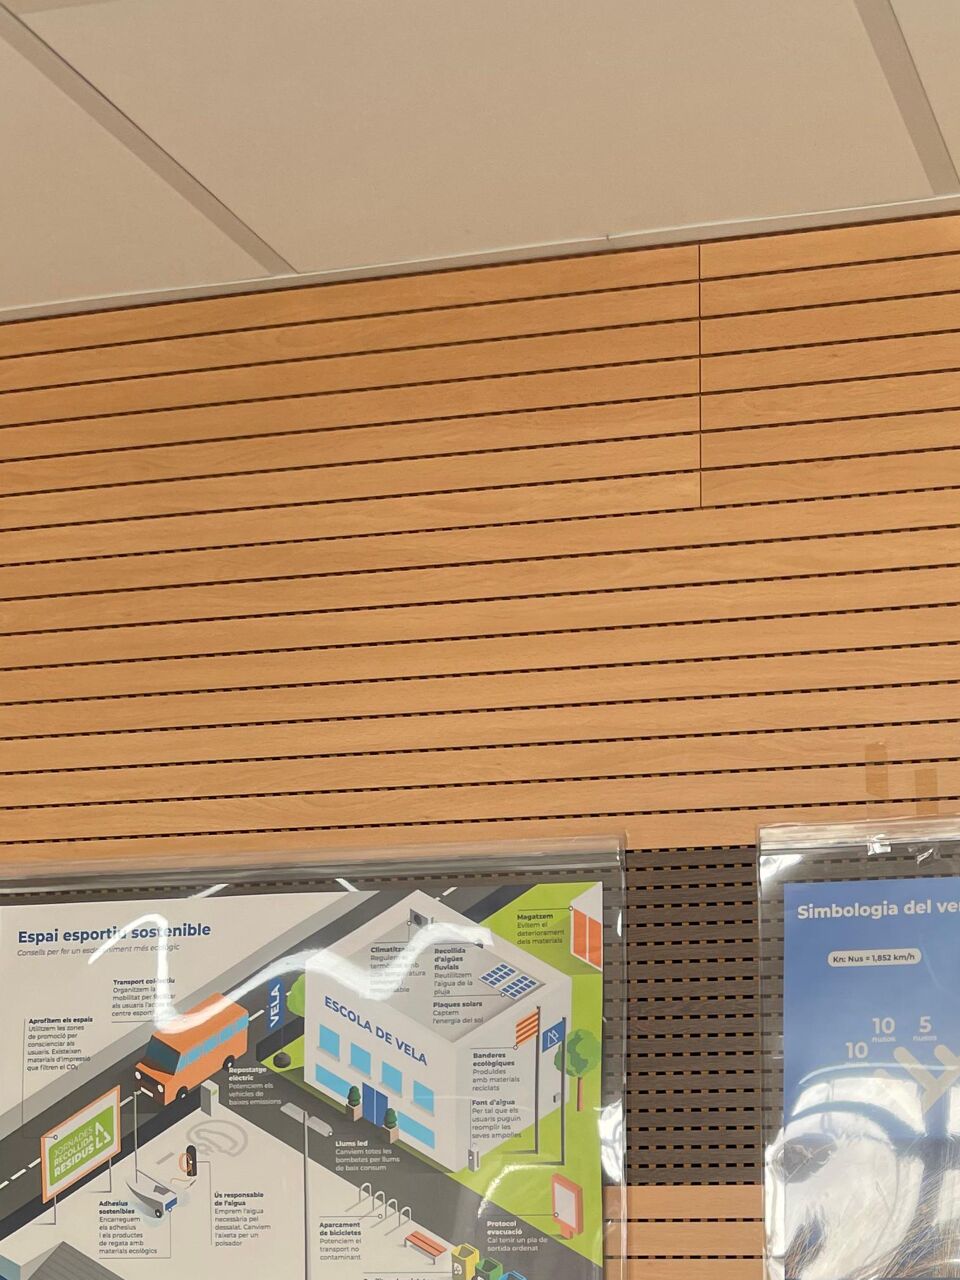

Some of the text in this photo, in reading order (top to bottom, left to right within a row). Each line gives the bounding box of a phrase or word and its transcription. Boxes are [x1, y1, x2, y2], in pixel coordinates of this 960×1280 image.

[517, 913, 553, 921] Magatzem
[798, 902, 898, 920] Simbologia
[904, 900, 931, 915] del
[18, 923, 211, 946] Espai esportiu sostenible
[833, 955, 846, 963] Kn:
[872, 954, 891, 964] 1,852
[893, 952, 915, 962] km/h
[270, 984, 280, 1028] VELA
[324, 996, 428, 1066] ESCOLA DE VELA
[872, 1018, 895, 1034] 10
[919, 1016, 932, 1033] 5
[845, 1042, 868, 1058] 10
[473, 1060, 515, 1068] ecològiques
[490, 1099, 515, 1107] d'aigua
[54, 1136, 94, 1167] RECOLLIDA
[54, 1146, 94, 1177] RESIDUS
[224, 1192, 264, 1200] responsable
